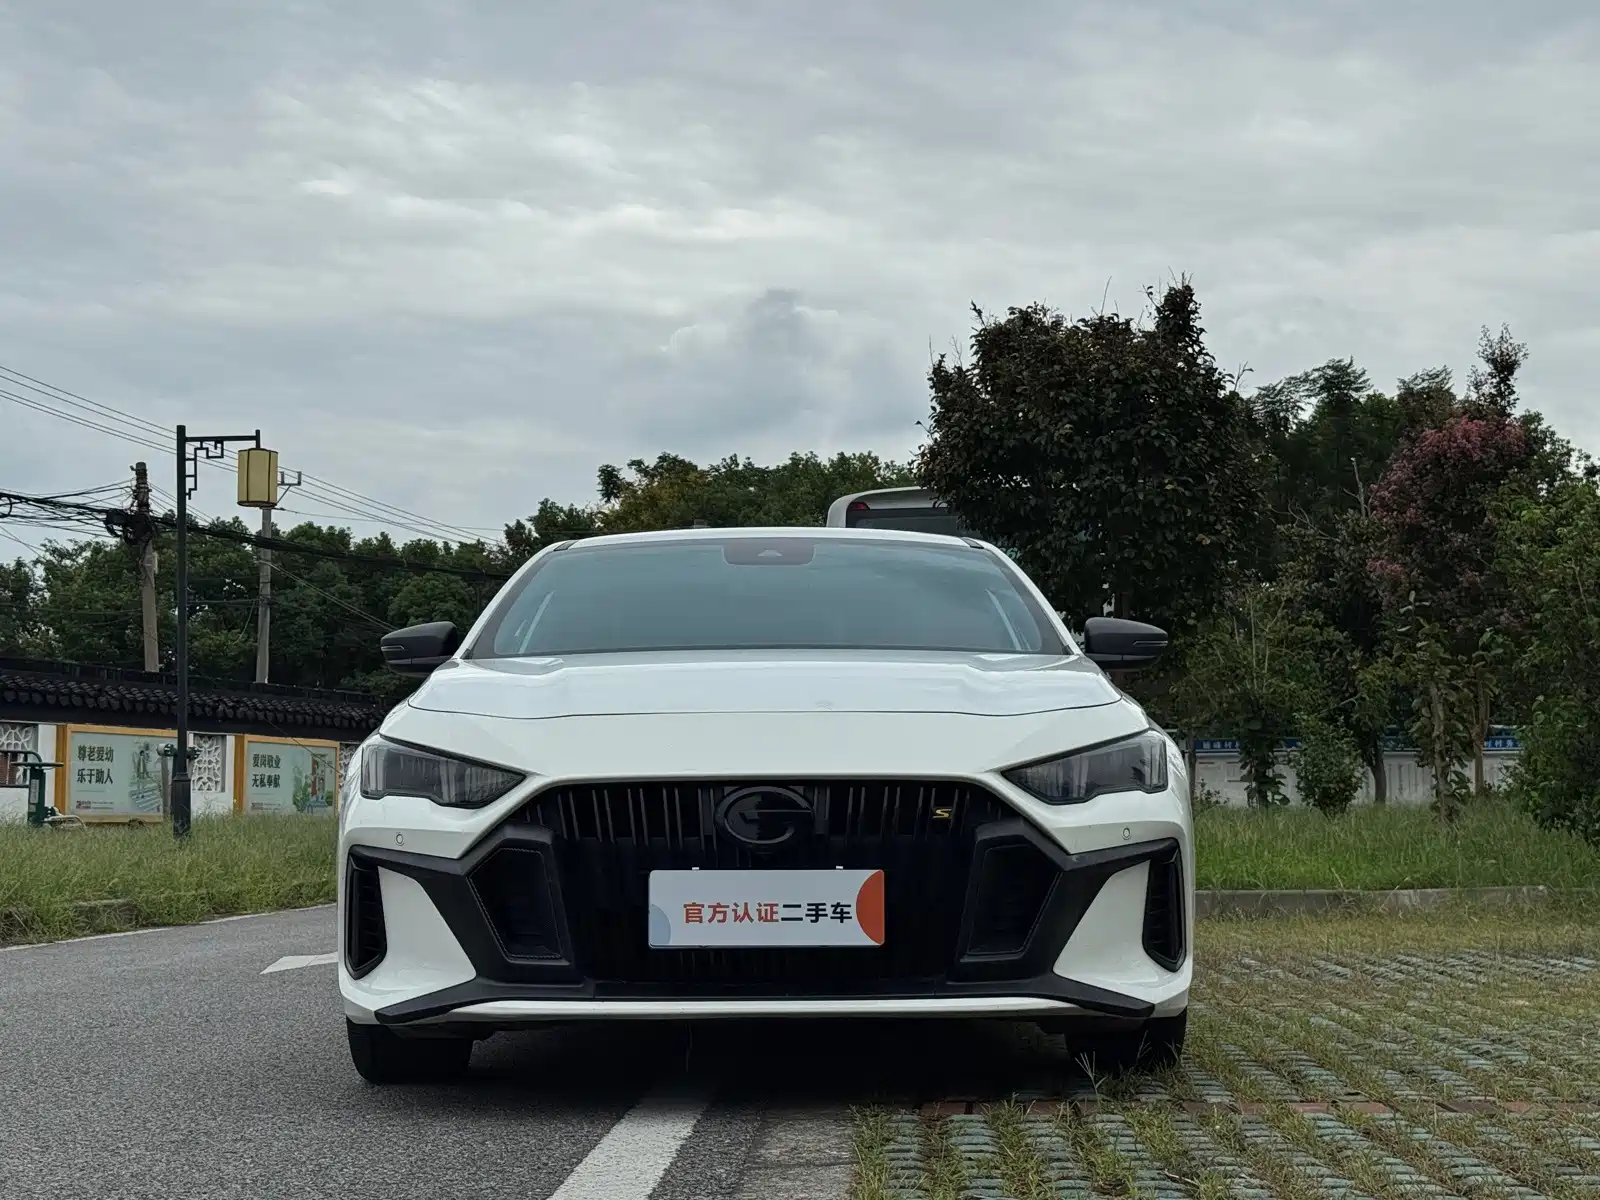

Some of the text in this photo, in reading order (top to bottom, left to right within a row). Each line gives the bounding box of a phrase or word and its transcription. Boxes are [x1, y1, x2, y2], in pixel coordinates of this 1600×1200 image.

[77, 745, 114, 763] 尊老爱幼
[252, 754, 281, 769] 爱岗敬业
[77, 768, 114, 785] 乐于助人
[252, 773, 280, 788] 无私奉献
[932, 808, 952, 819] S
[683, 902, 852, 924] 官方认证二手车
